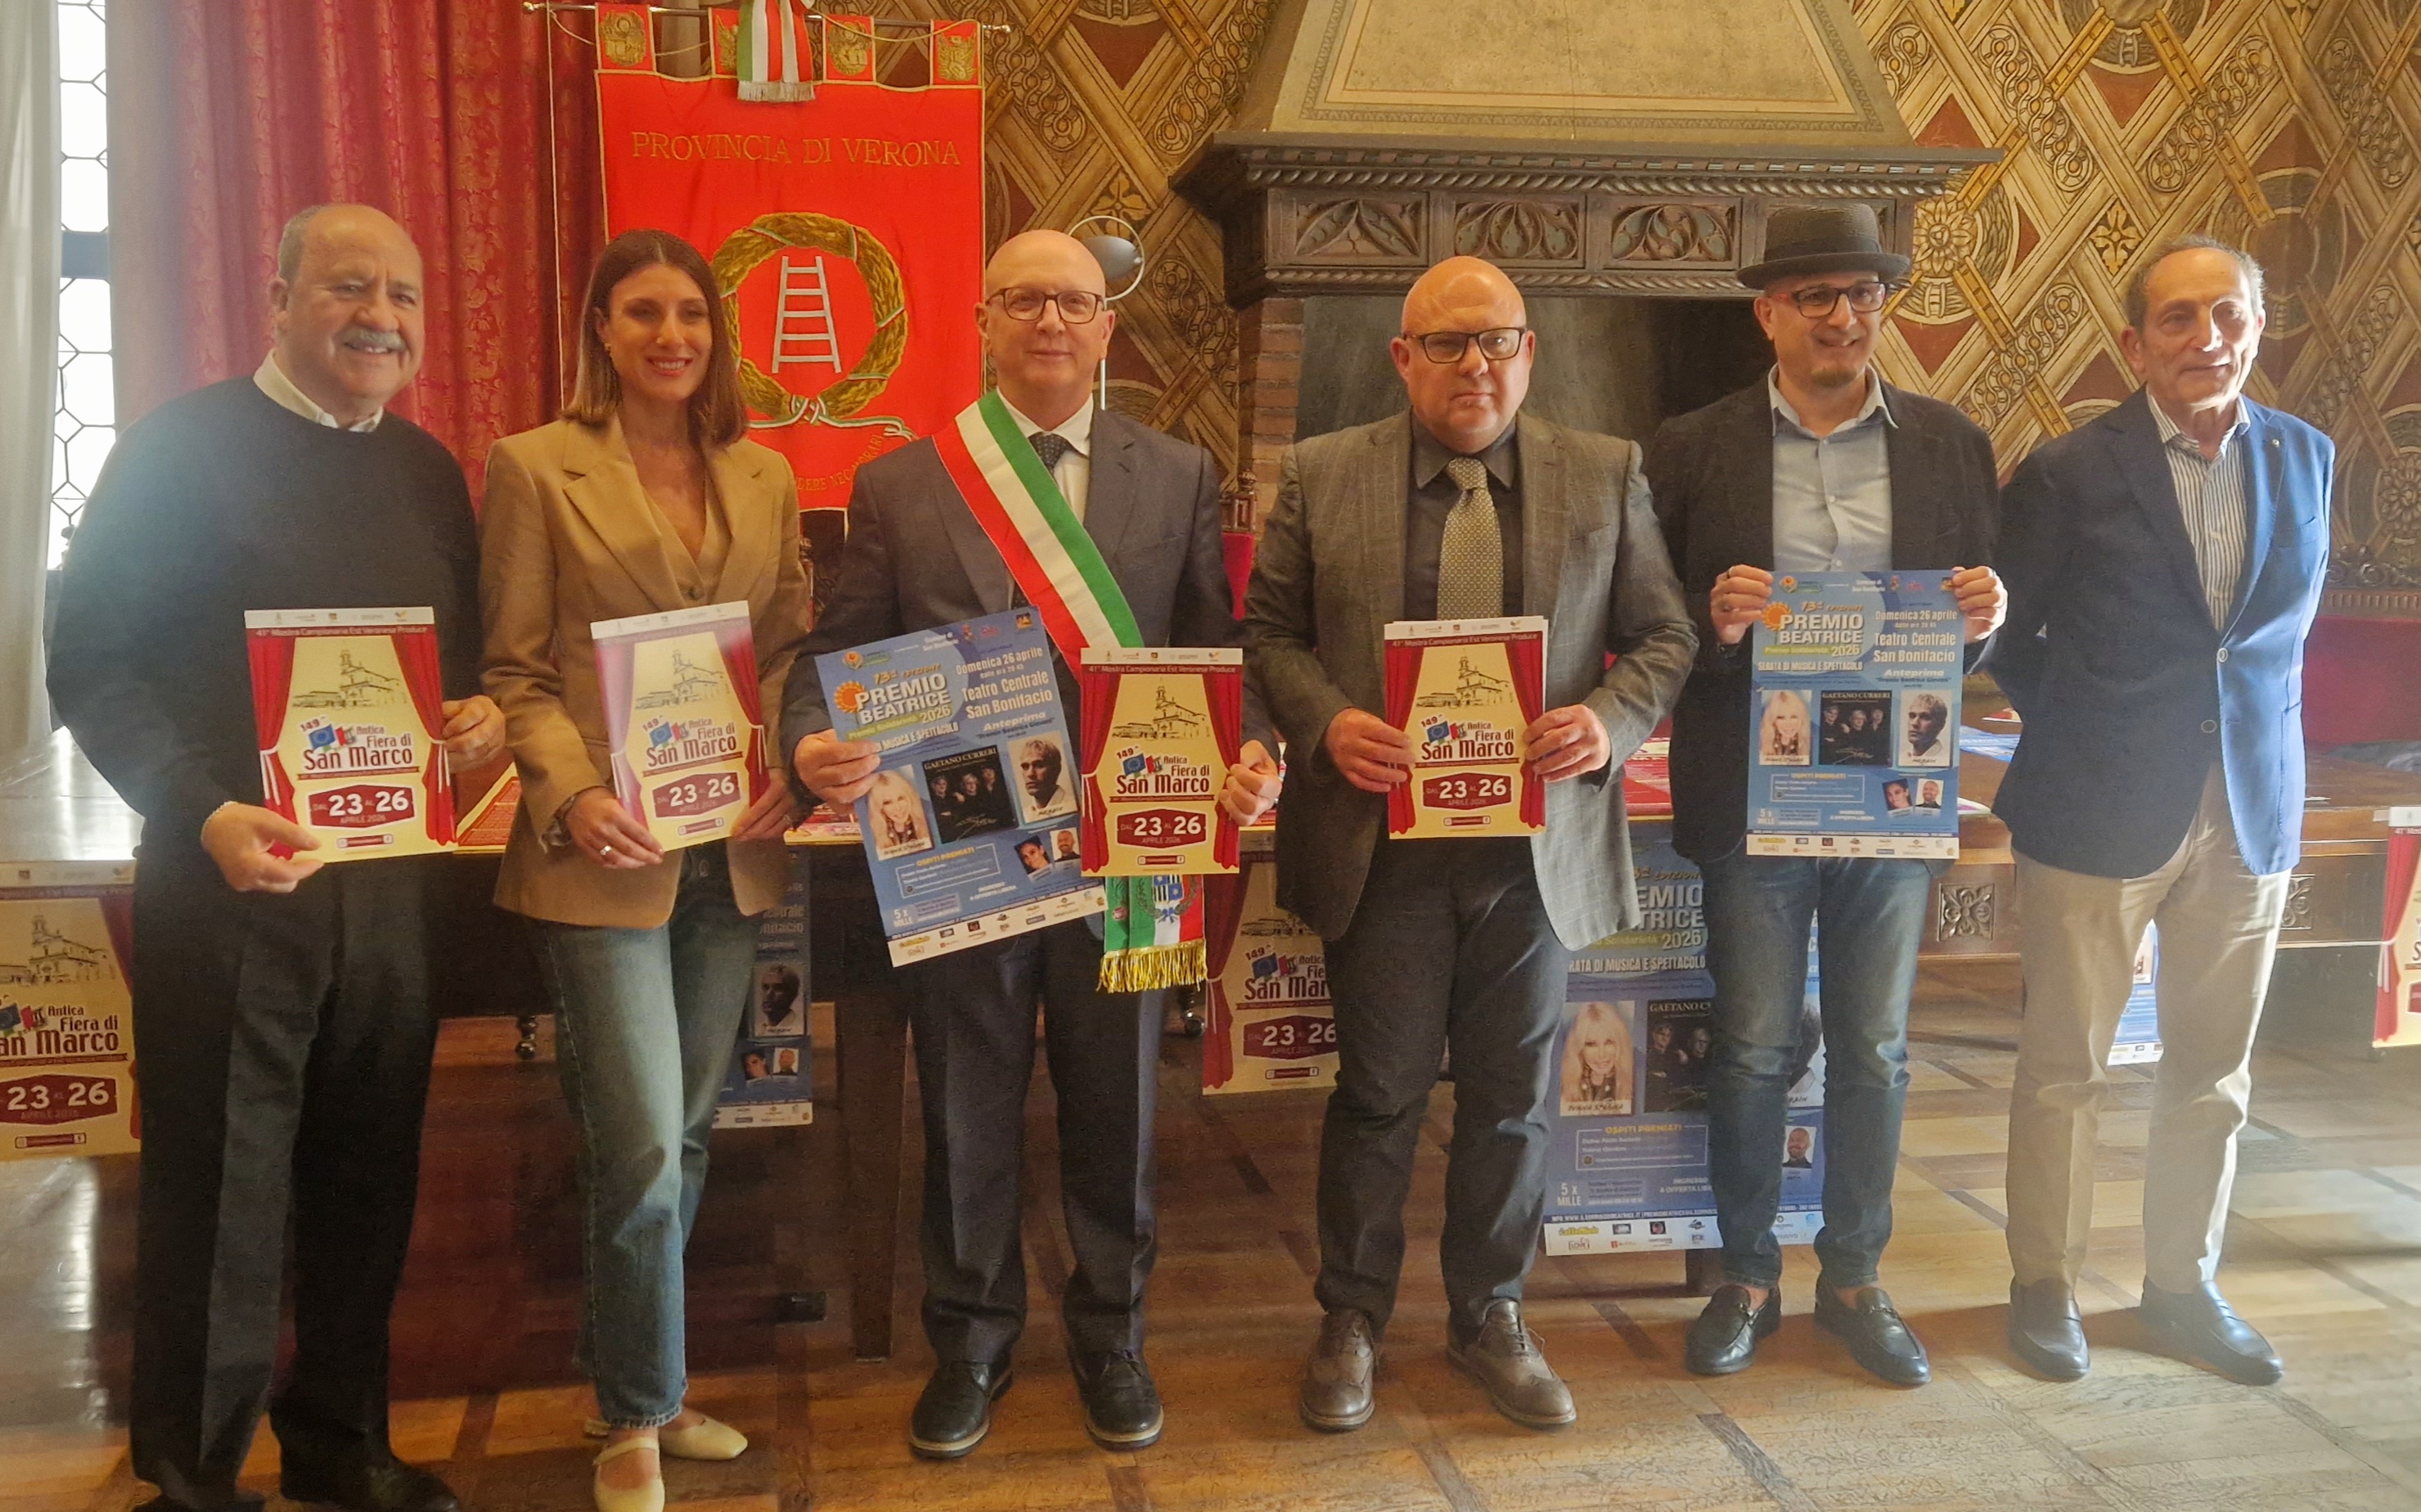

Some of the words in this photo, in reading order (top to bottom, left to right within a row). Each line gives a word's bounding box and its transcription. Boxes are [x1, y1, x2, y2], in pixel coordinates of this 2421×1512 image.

[631, 132, 791, 164] PROVINCIA
[803, 138, 833, 164] DI
[842, 138, 961, 167] VERONA
[796, 476, 827, 491] DERE
[1780, 614, 1864, 630] PREMIO
[1875, 610, 1918, 619] Domenica
[1919, 611, 1930, 620] 26
[1932, 610, 1957, 621] aprile
[1780, 631, 1863, 644] BEATRICE
[1874, 632, 1907, 646] Teatro
[1912, 632, 1955, 646] Centrale
[1832, 645, 1861, 657] 2026
[1874, 650, 1895, 662] San
[1899, 649, 1955, 662] Bonifacio
[956, 656, 1001, 675] Domenica
[1002, 653, 1015, 664] 26
[1016, 647, 1042, 663] aprile
[1884, 668, 1944, 677] Anteprima
[855, 673, 947, 711] PREMIO
[962, 682, 997, 702] Teatro
[1001, 670, 1049, 693] Centrale
[860, 690, 951, 725] BEATRICE
[966, 703, 991, 719] San
[992, 688, 1053, 713] Bonifacio
[920, 705, 951, 723] 2026
[983, 712, 1046, 731] Anteprima
[356, 726, 385, 734] Antica
[698, 727, 722, 740] Fiera
[727, 722, 735, 734] di
[884, 734, 910, 749] MUSICA
[911, 732, 916, 741] E
[917, 722, 959, 740] SPETTACOLO
[1475, 731, 1501, 741] Fiera
[1505, 729, 1514, 740] di
[367, 736, 397, 748] Fiera
[401, 733, 412, 746] di
[1421, 742, 1452, 760] San
[1459, 740, 1514, 758] Marco
[304, 749, 341, 770] San
[349, 746, 412, 767] Marco
[646, 745, 678, 767] San
[683, 736, 736, 760] Marco
[925, 756, 962, 770] GAETANO
[962, 747, 997, 762] CURRERI
[1163, 756, 1187, 764] Antica
[1172, 765, 1197, 776] Fiera
[1200, 765, 1209, 776] di
[669, 784, 697, 807] 23
[707, 776, 735, 799] 26
[1117, 775, 1148, 794] San
[1155, 775, 1209, 794] Marco
[1439, 781, 1467, 799] 23
[1478, 778, 1506, 797] 26
[328, 794, 363, 816] 23
[375, 790, 408, 812] 26
[1134, 817, 1163, 836] 23
[1173, 816, 1202, 835] 26
[1637, 884, 1703, 908] EMIO
[1640, 909, 1705, 929] TRICE
[1662, 930, 1702, 950] 2026
[1307, 965, 1325, 978] Fie
[1568, 959, 1592, 973] RATA
[1595, 958, 1603, 973] DI
[1604, 956, 1641, 973] MUSICA
[1643, 956, 1649, 971] E
[1651, 956, 1706, 970] SPETTACOLO
[1244, 979, 1280, 1000] San
[1288, 976, 1325, 998] Mar
[47, 1006, 84, 1016] Antica
[1649, 1002, 1698, 1012] GAETANO
[61, 1018, 99, 1032] Fiera
[104, 1015, 118, 1030] di
[0, 1037, 26, 1055] an
[36, 1030, 119, 1055] Marco
[1262, 1025, 1294, 1046] 23
[1308, 1023, 1336, 1044] 26
[7, 1085, 50, 1110] 23
[68, 1081, 109, 1106] 26
[1561, 1182, 1568, 1195] 5
[1557, 1196, 1582, 1206] MILLE
